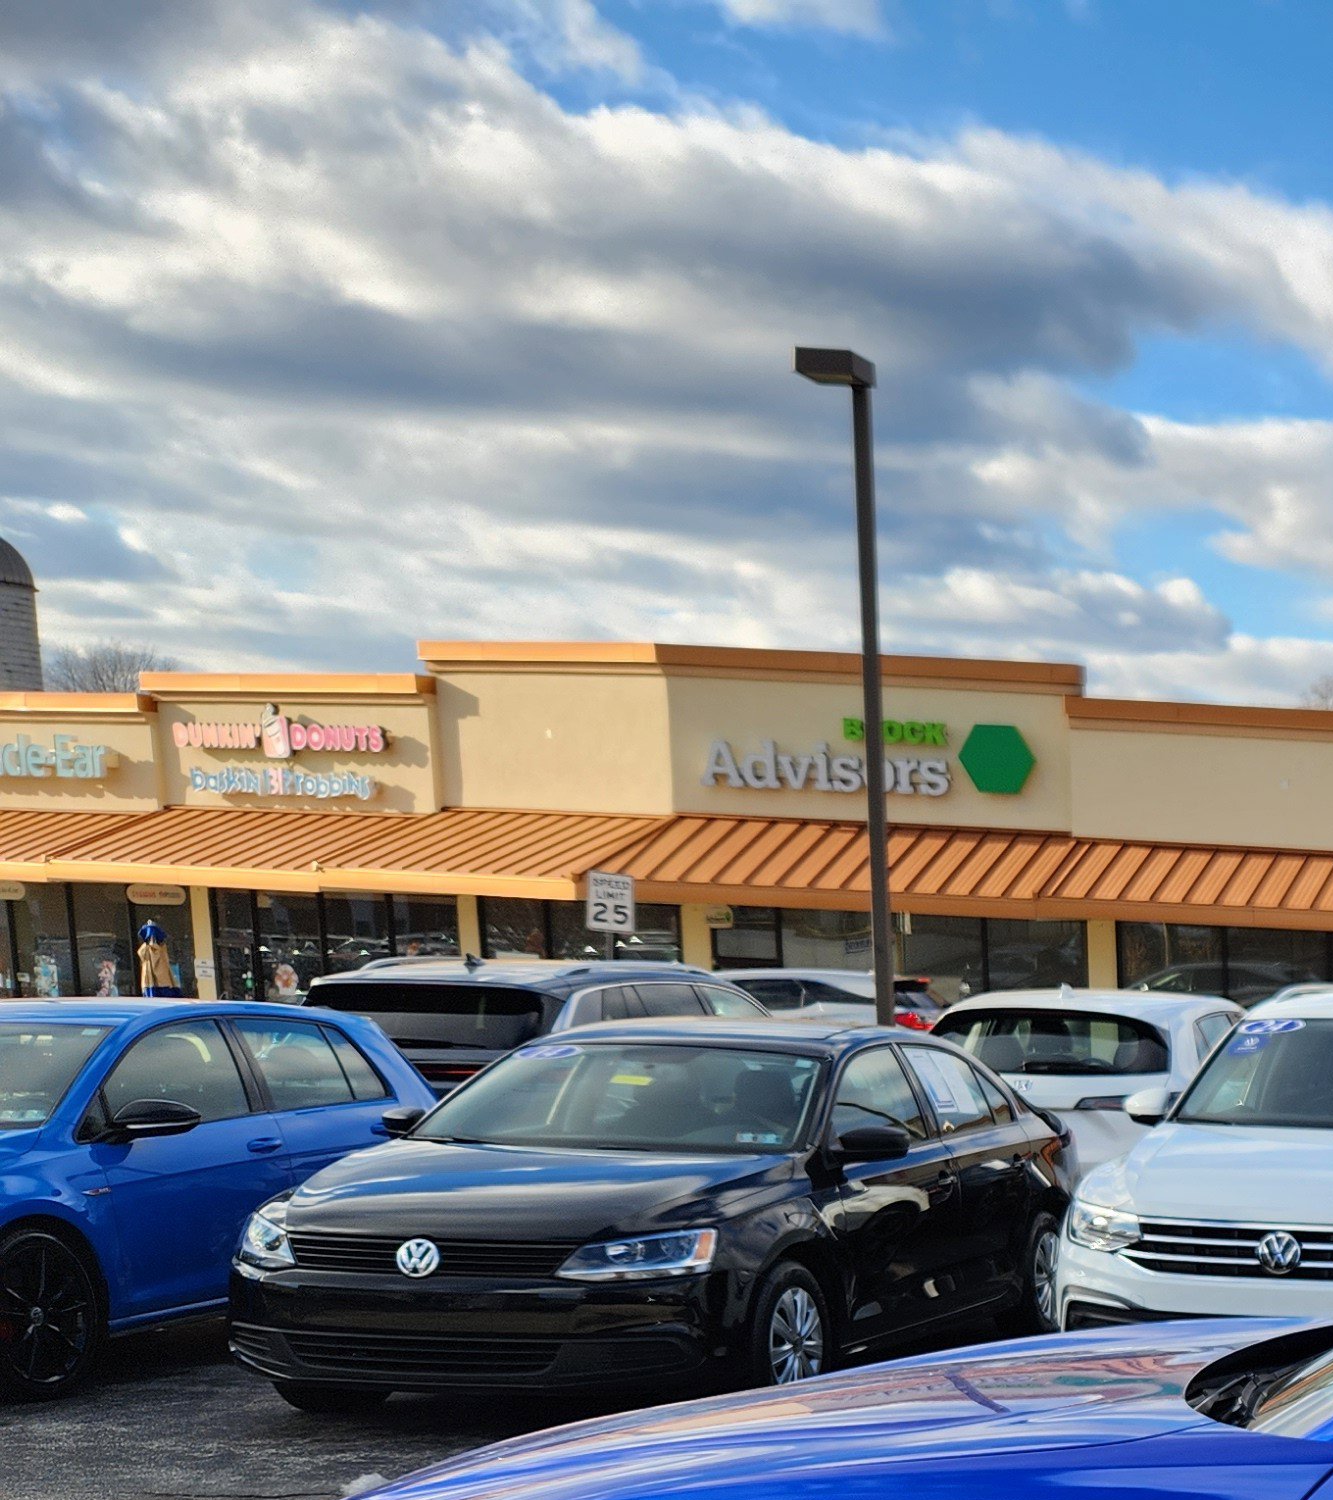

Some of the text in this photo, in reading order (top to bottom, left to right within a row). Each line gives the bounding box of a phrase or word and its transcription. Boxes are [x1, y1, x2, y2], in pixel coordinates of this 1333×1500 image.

[289, 722, 385, 752] DONUTS
[843, 717, 947, 746] BOCK
[0, 733, 107, 778] cle-Ear
[595, 889, 626, 899] LIMIT
[593, 902, 629, 925] 25
